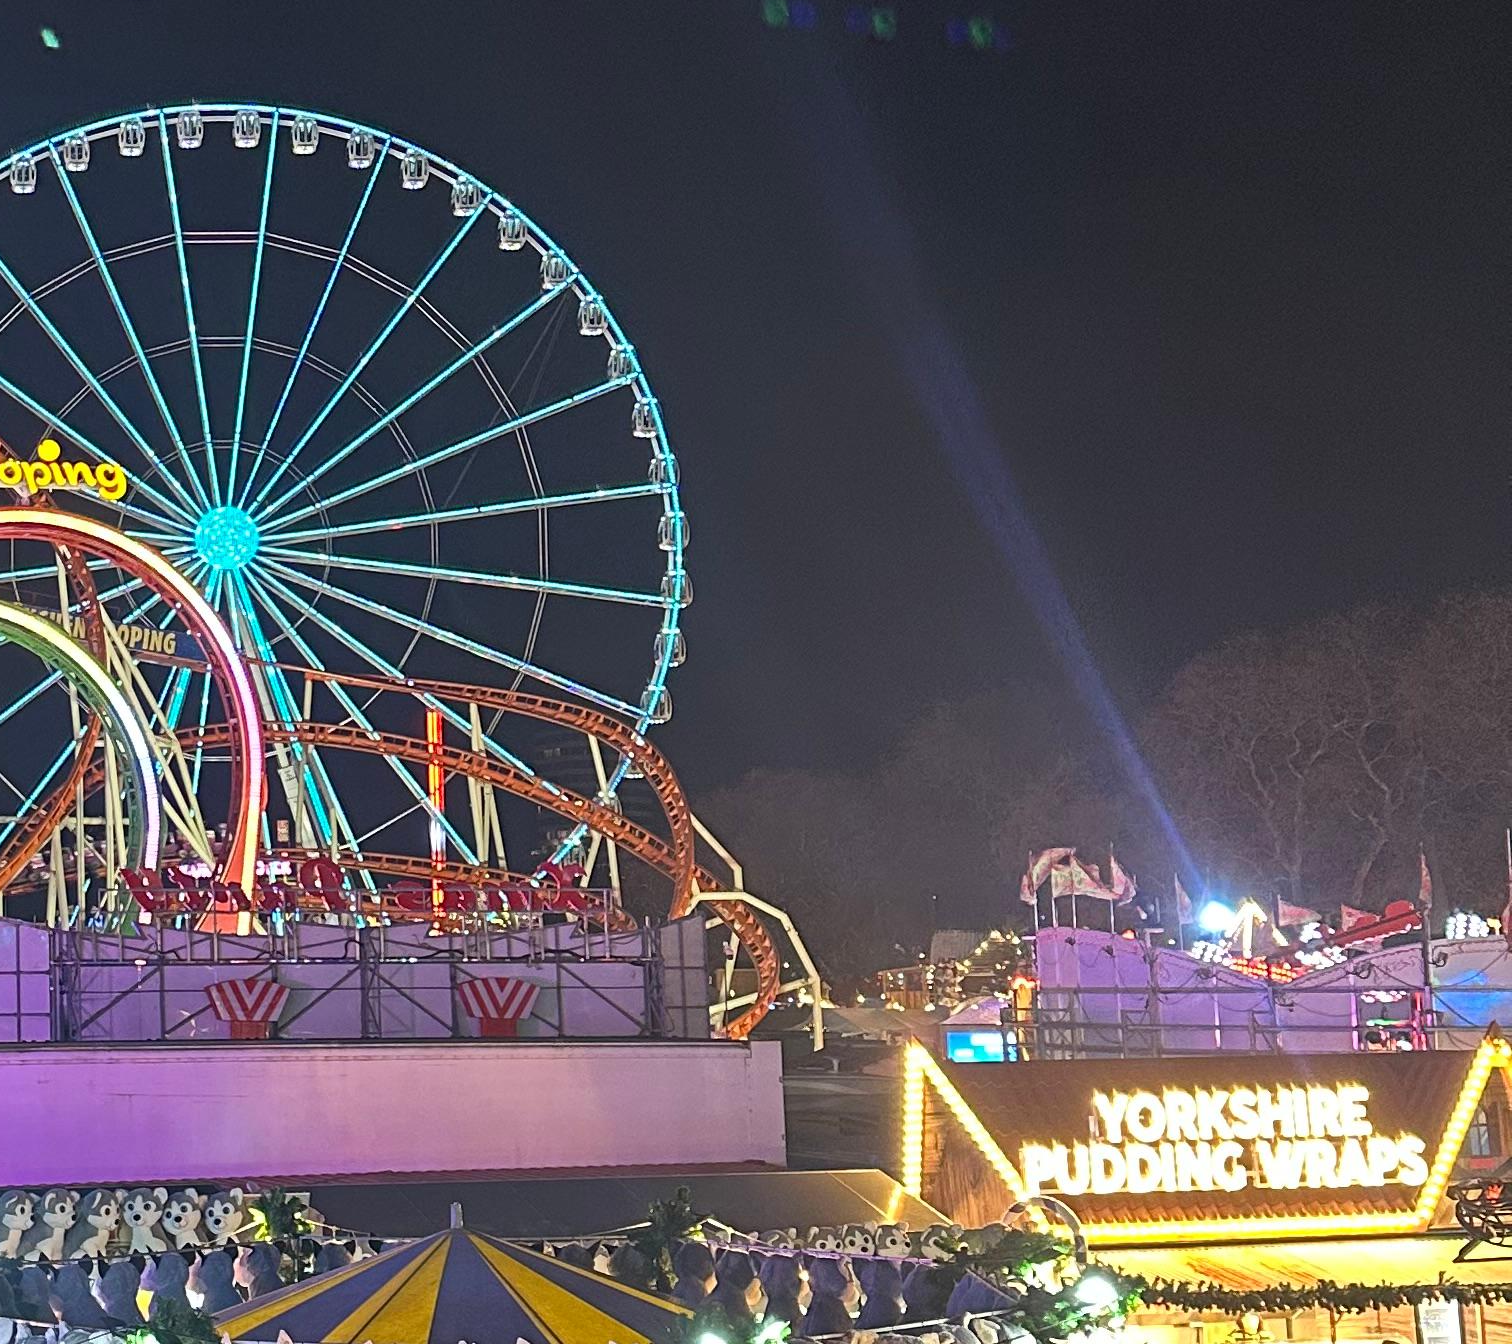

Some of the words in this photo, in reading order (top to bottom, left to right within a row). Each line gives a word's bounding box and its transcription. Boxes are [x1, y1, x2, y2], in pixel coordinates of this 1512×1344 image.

[116, 623, 177, 655] OPING
[1091, 1084, 1373, 1146] YORKSHIRE
[1022, 1138, 1247, 1197] PUDDING
[1254, 1134, 1430, 1192] WRAPS
